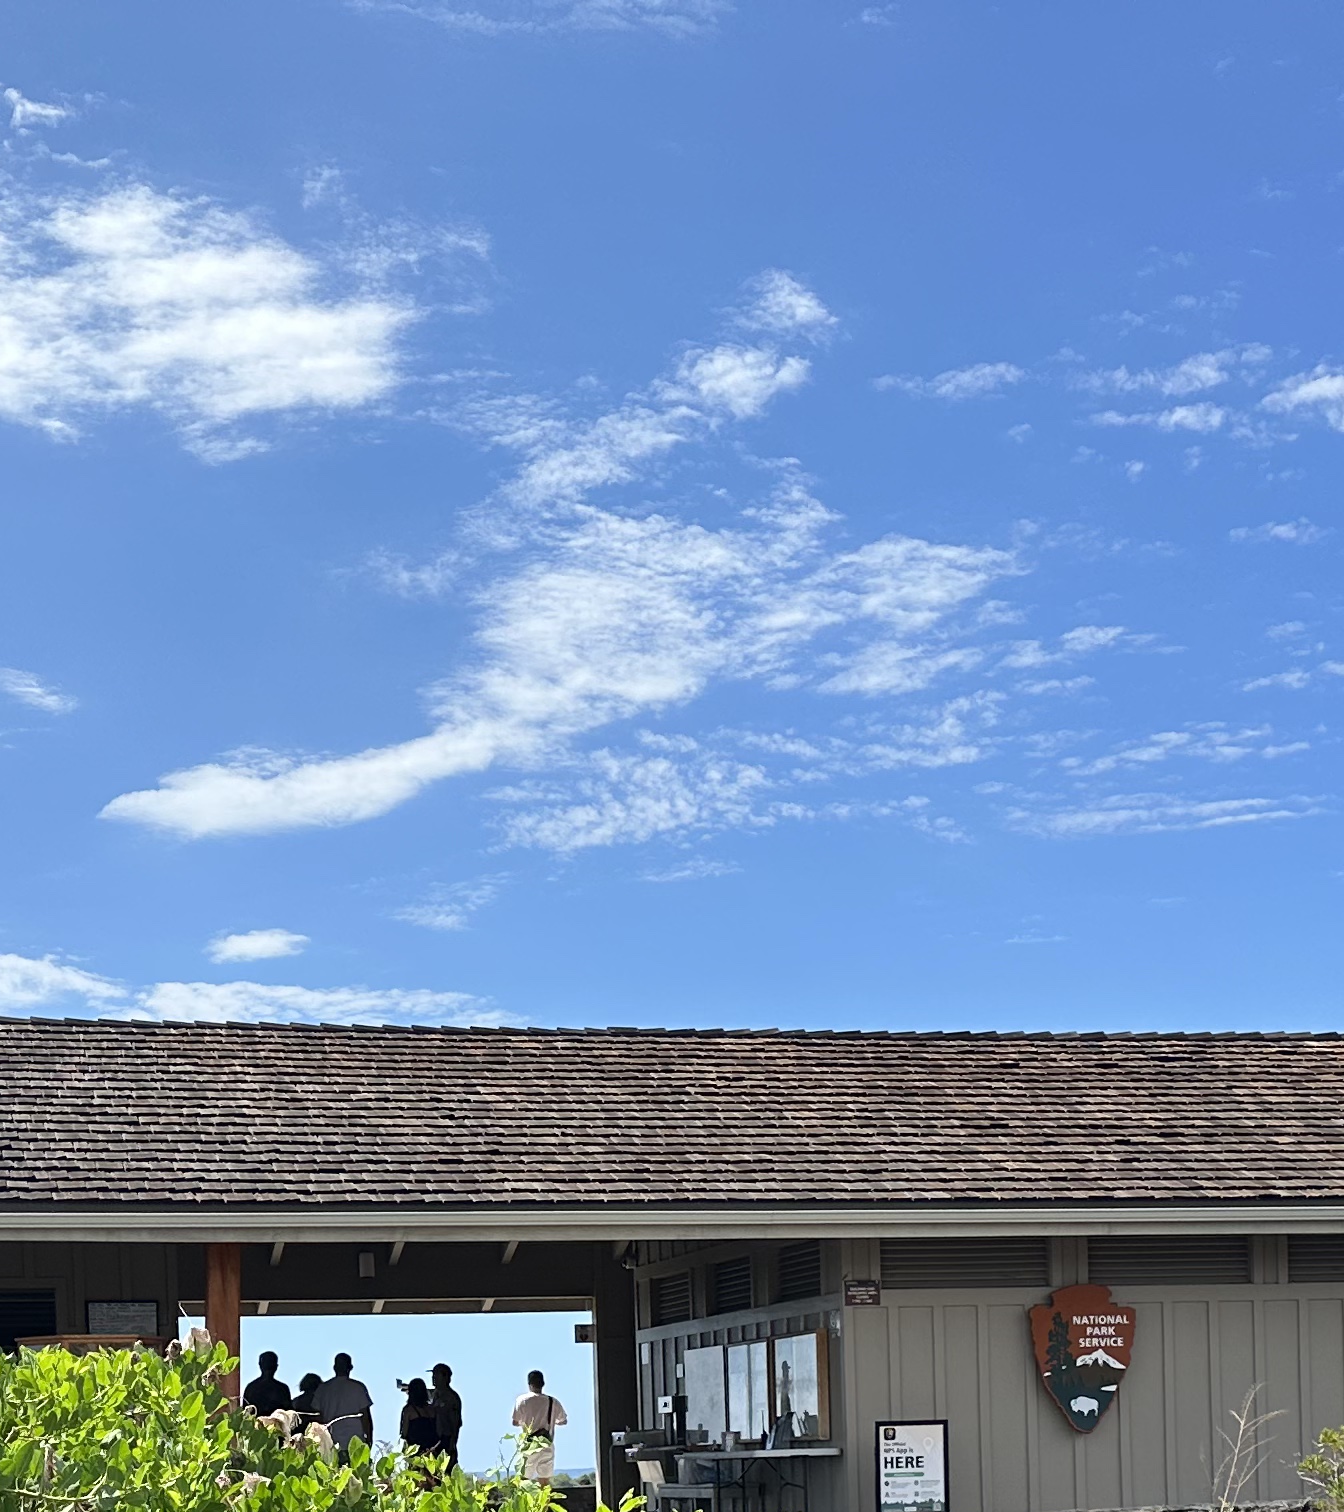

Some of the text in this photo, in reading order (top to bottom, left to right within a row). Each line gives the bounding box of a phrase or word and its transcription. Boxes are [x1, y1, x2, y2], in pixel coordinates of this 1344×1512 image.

[1072, 1314, 1130, 1325] NATIONAL
[1086, 1326, 1116, 1336] PARK
[1078, 1337, 1125, 1348] SERVICE
[884, 1455, 925, 1469] HERE
